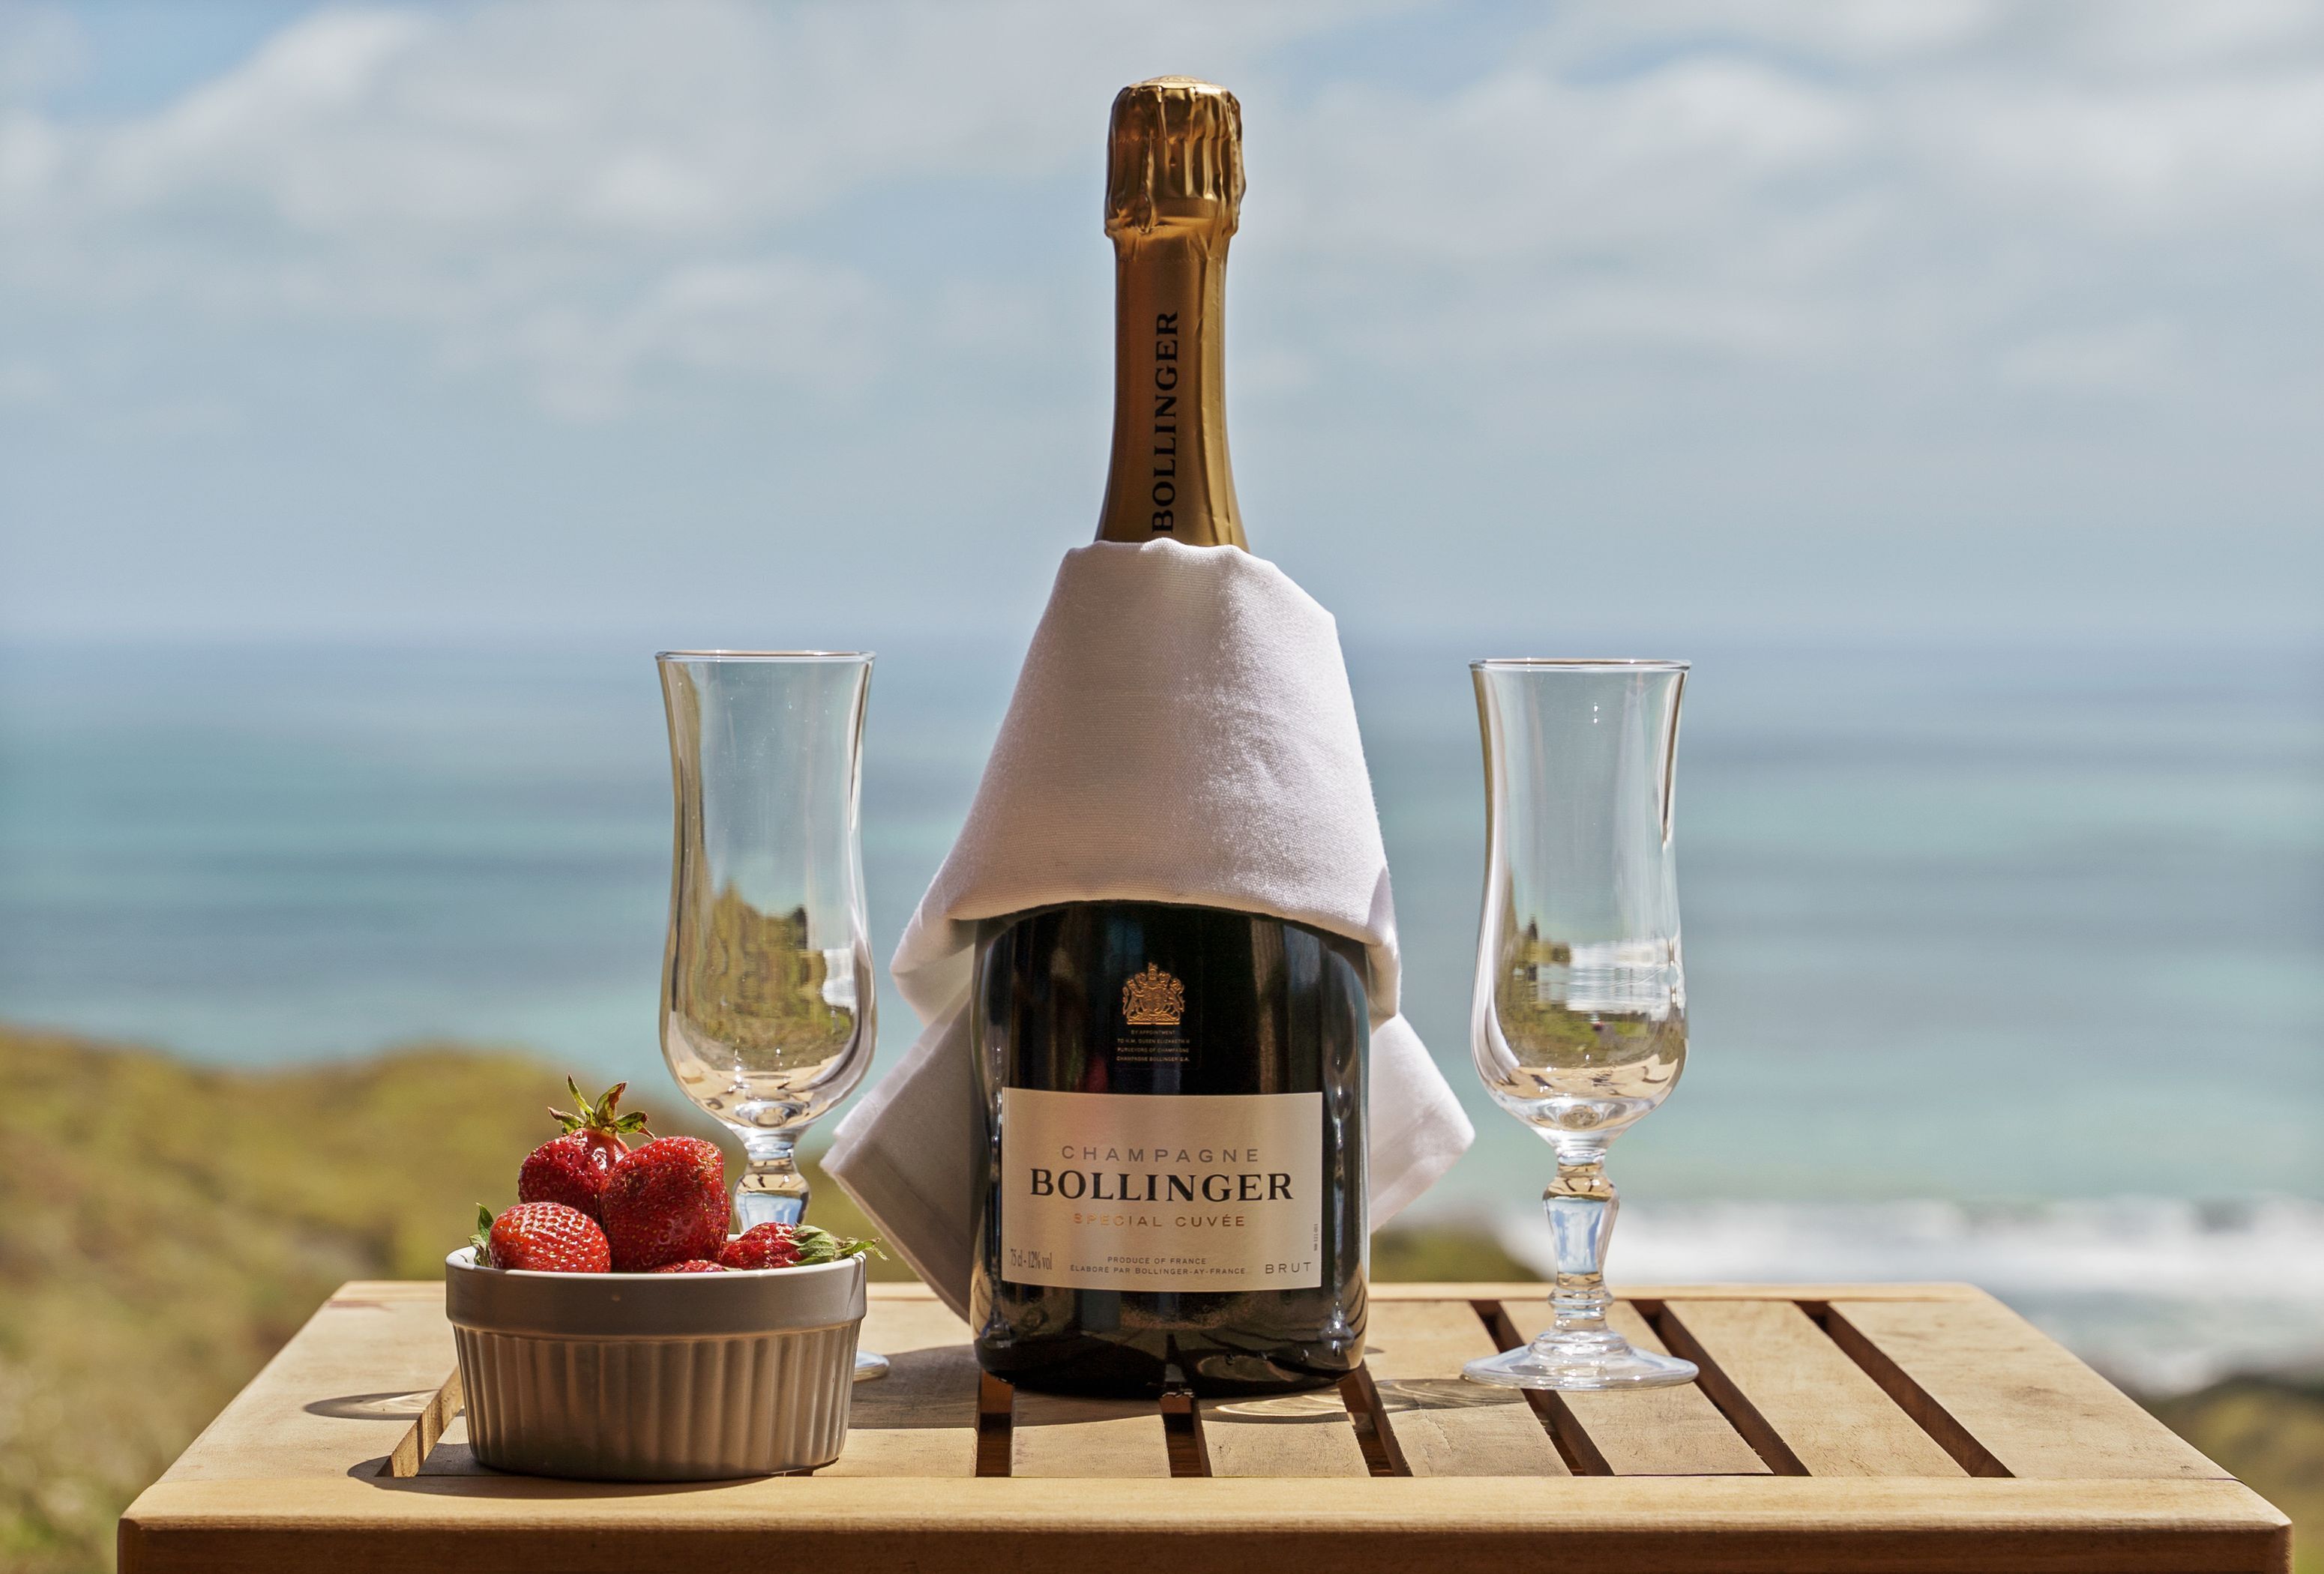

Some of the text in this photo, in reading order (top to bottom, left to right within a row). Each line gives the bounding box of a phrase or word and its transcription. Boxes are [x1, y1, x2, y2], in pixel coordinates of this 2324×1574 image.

[1151, 310, 1178, 534] BOLLINGER
[1061, 1145, 1259, 1163] CHAMPAGNE
[1029, 1168, 1294, 1203] BOLLINGER
[1073, 1213, 1246, 1228] SPECIAL CUVÉE
[1107, 1256, 1151, 1264] PRODUCE
[1154, 1257, 1166, 1265] OF
[1265, 1261, 1312, 1274] BRUT
